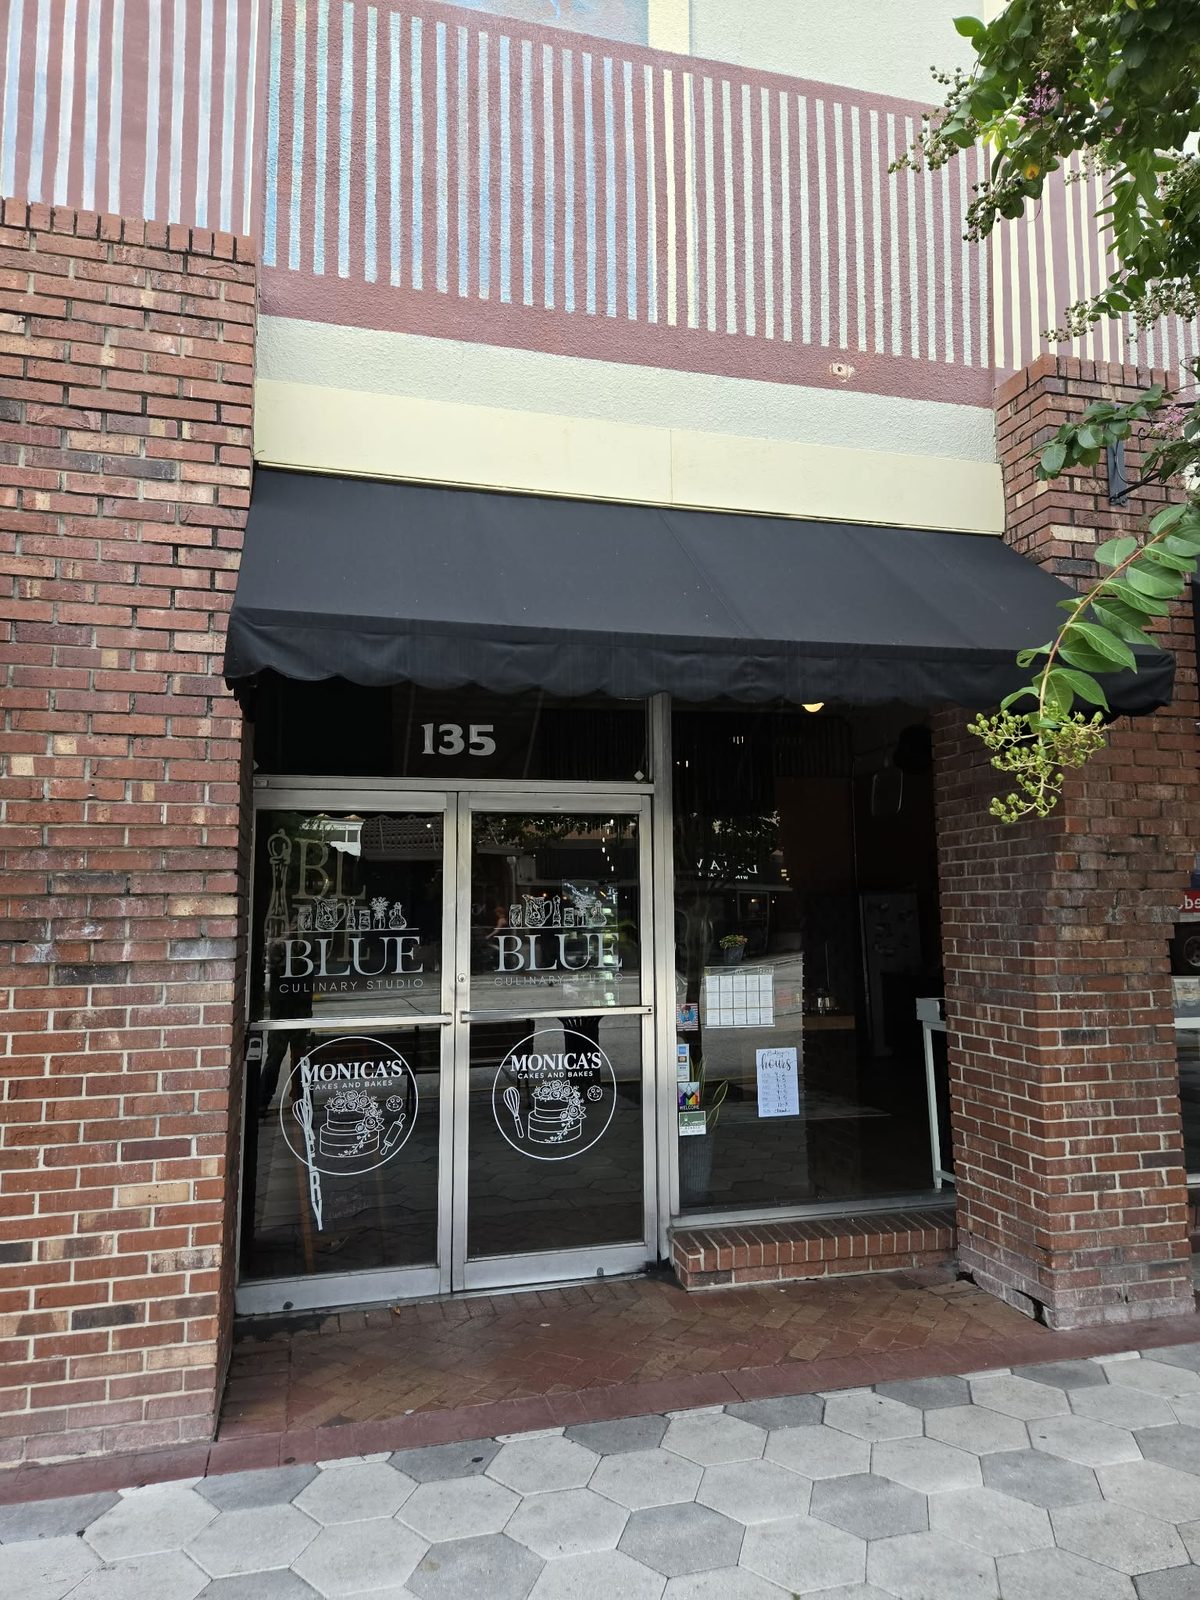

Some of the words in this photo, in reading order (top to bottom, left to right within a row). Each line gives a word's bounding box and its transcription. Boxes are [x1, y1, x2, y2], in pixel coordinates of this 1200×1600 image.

[421, 722, 497, 757] 135
[279, 935, 424, 979] BLUE
[493, 931, 623, 973] BLUE
[278, 980, 358, 995] CULINARY
[366, 977, 424, 991] STUDIO
[493, 974, 565, 987] CULINARY
[301, 1059, 403, 1083] MONICA'S
[510, 1052, 602, 1071] MONICA'S
[308, 1082, 338, 1091] CAKES
[342, 1081, 361, 1089] AND
[365, 1079, 393, 1088] BAKES
